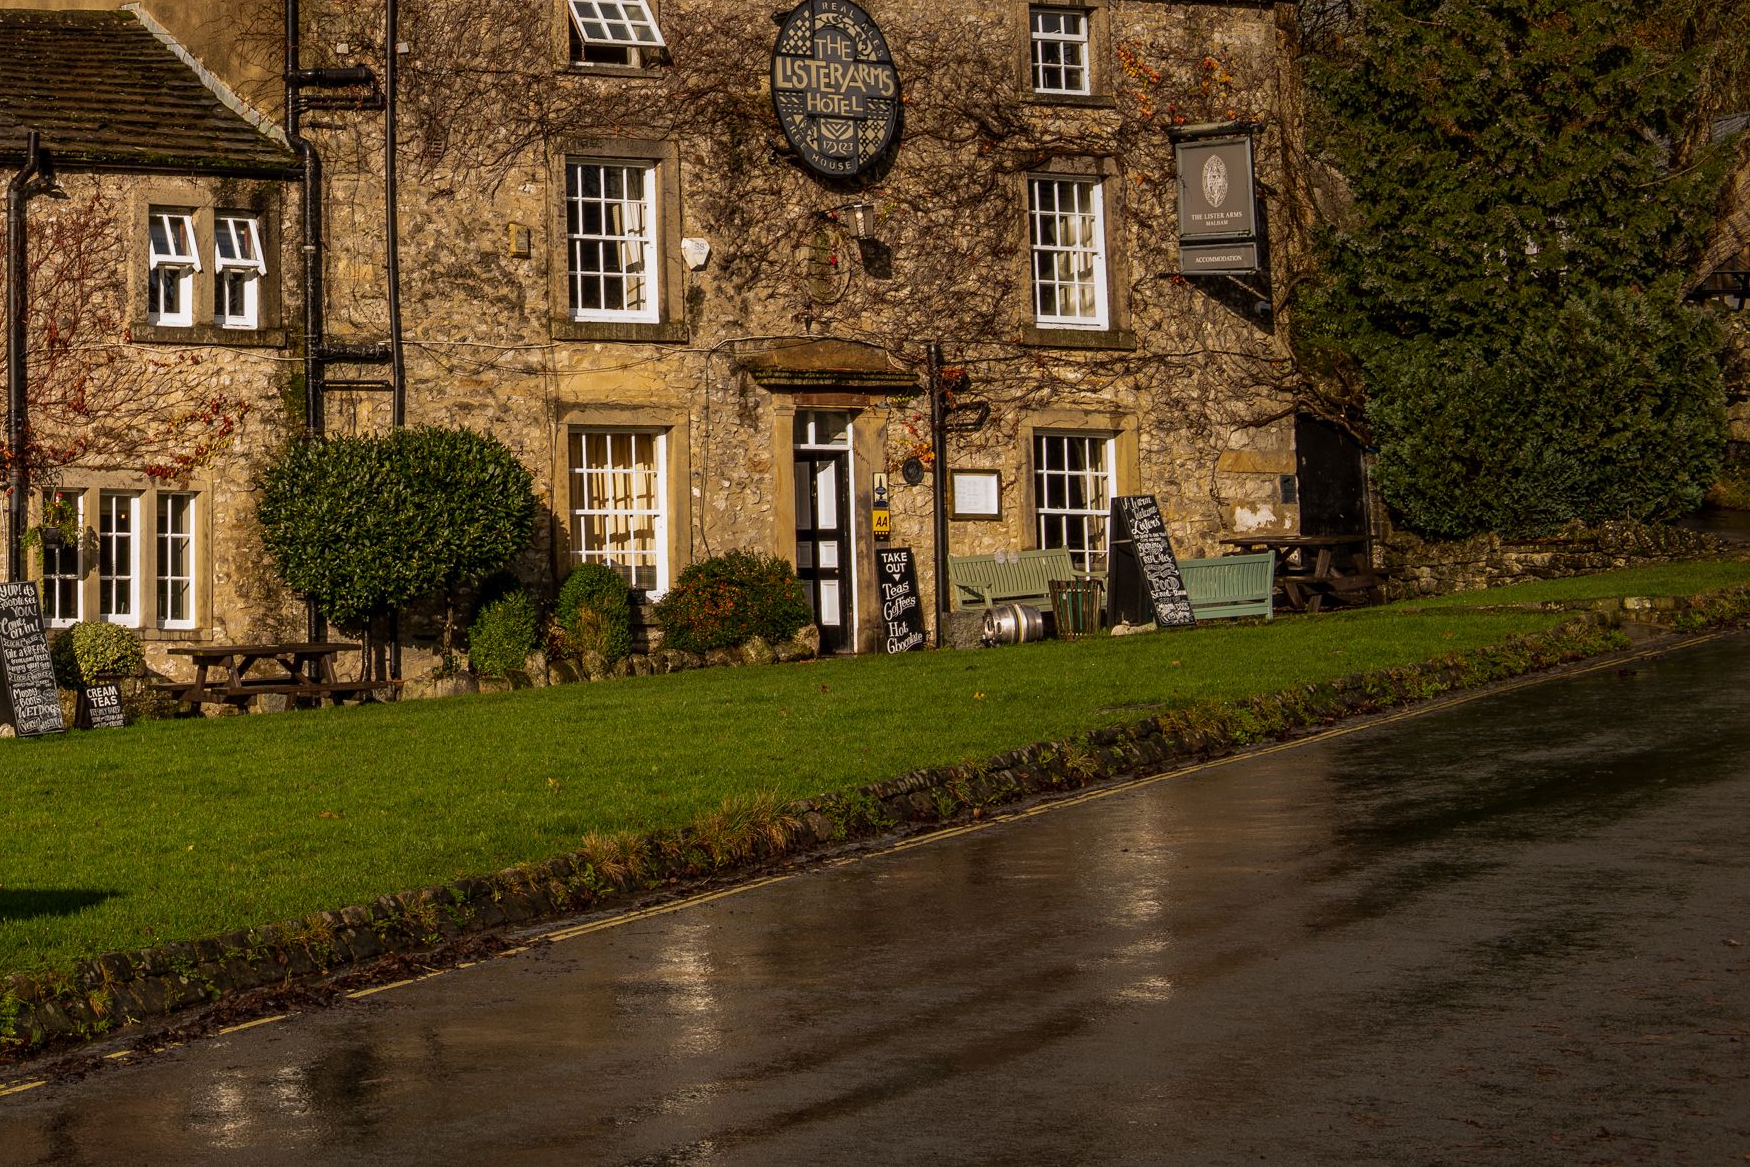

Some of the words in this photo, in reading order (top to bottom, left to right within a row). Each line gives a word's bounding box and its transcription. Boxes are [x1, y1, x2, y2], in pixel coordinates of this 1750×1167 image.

[822, 2, 855, 19] REAL
[861, 22, 884, 57] ALES
[814, 35, 853, 61] THE
[775, 56, 843, 93] LISTER
[840, 63, 895, 96] ARMS
[807, 92, 864, 116] HOTEL
[785, 116, 807, 151] FREE
[811, 153, 852, 170] HOUSE
[1195, 254, 1242, 263] ACCOMMODATION
[876, 516, 887, 527] AA
[881, 552, 908, 563] TAKE
[885, 562, 907, 573] OUT
[882, 581, 910, 599] Teas
[888, 622, 909, 637] Hot
[86, 685, 118, 698] CREAM
[91, 695, 118, 707] TEAS
[18, 706, 38, 718] WET
